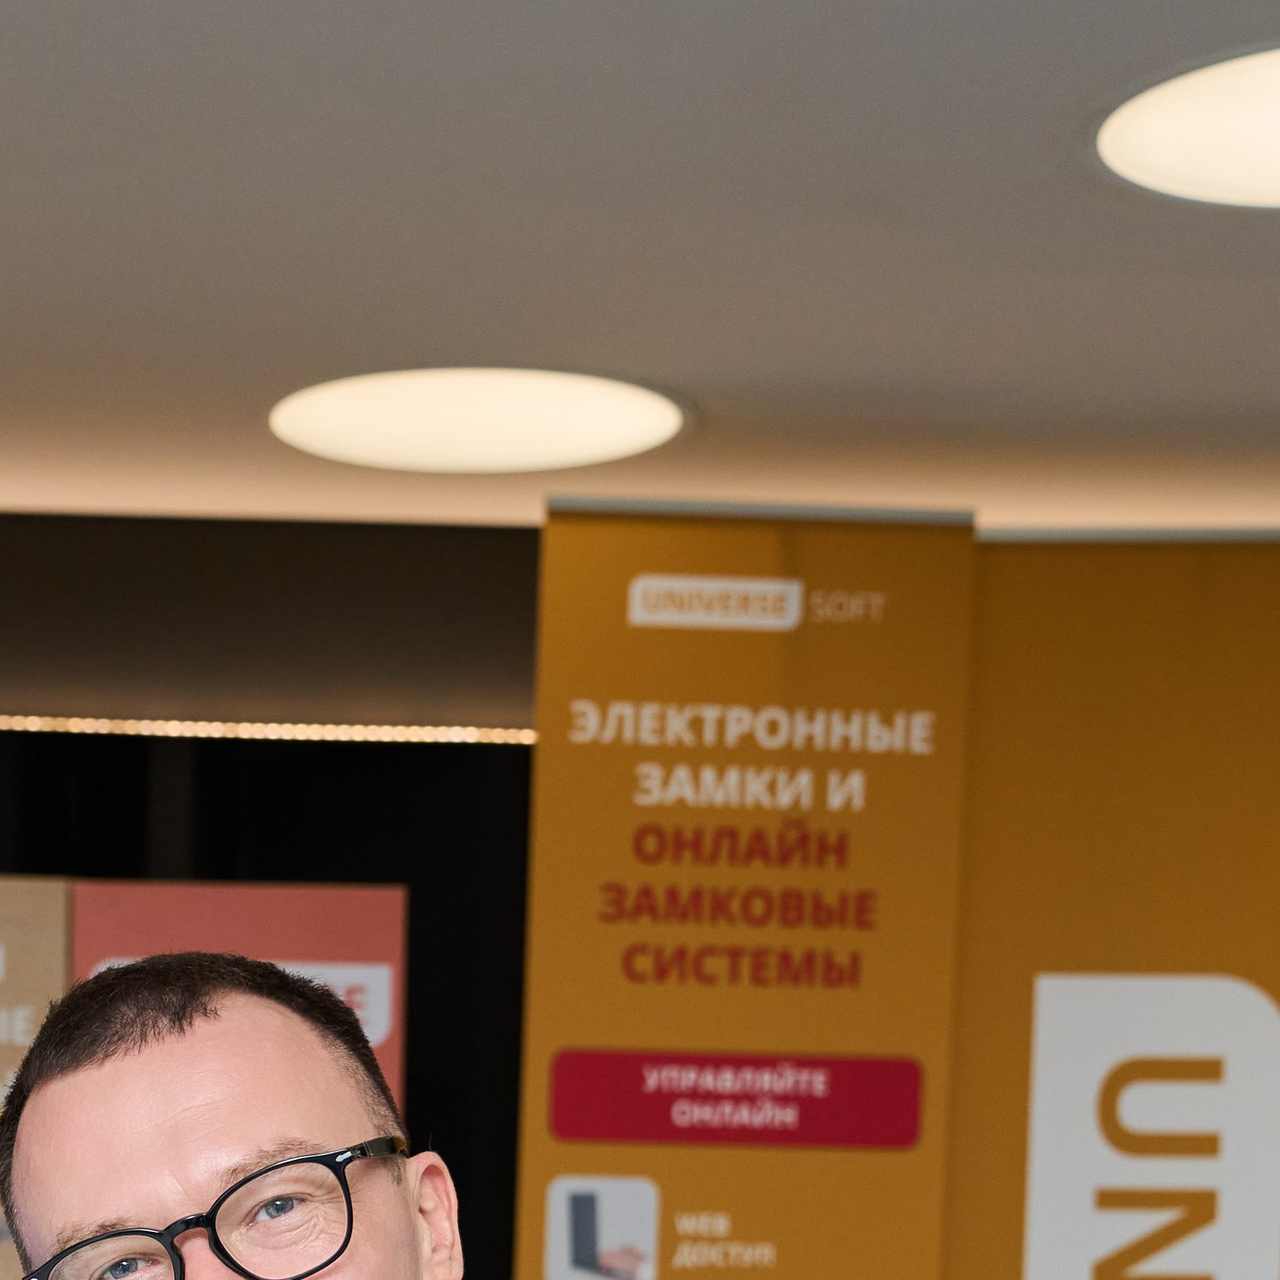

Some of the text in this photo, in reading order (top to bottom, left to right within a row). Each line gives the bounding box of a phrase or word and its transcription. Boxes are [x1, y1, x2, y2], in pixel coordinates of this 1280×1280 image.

[567, 699, 937, 755] ЭЛЕКТРОННЫЕ
[633, 763, 866, 814] ЗАМКИ И
[632, 817, 850, 871] ОНЛАЙН
[597, 882, 879, 933] ЗАМКОВЫЕ
[622, 942, 862, 991] СИСТЕМЫ
[642, 1063, 831, 1099] УПРАВЛЯЙТЕ
[671, 1097, 799, 1132] ОНЛАЙН
[674, 1211, 731, 1237] WEB
[672, 1242, 777, 1271] ДОСТУП
